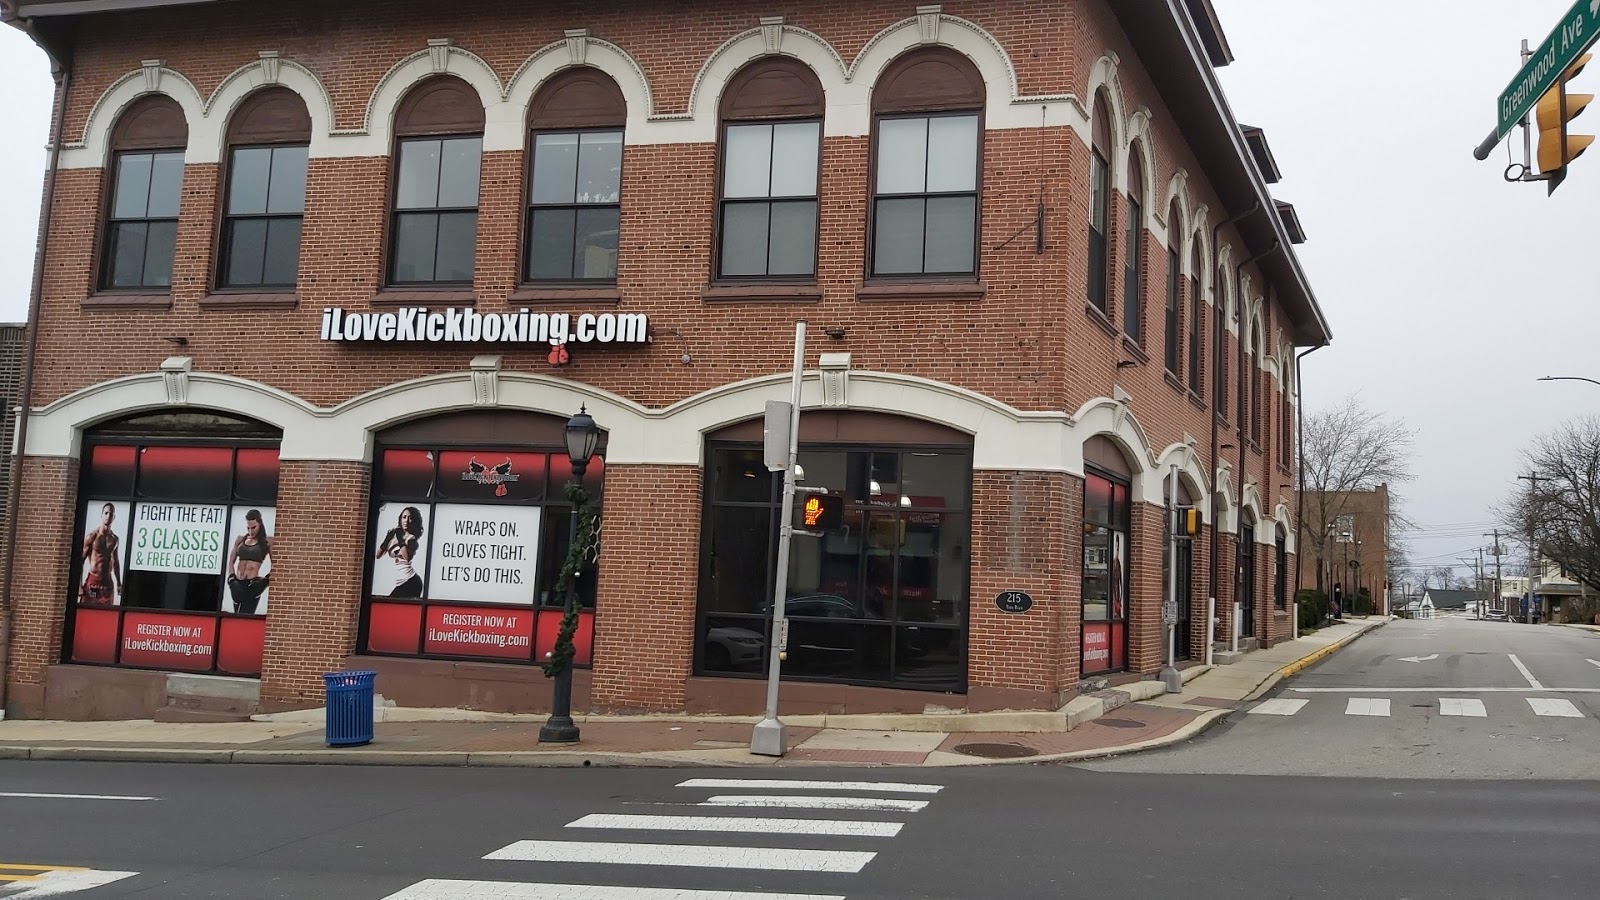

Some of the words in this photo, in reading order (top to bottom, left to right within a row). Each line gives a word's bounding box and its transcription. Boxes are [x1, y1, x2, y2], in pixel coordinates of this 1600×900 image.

[1502, 38, 1556, 121] Greenwood
[1561, 13, 1583, 55] Ave
[320, 307, 648, 345] iLoveKickboxing.com
[140, 504, 174, 522] FIGHT
[176, 507, 197, 523] THE
[200, 507, 223, 524] FAT!
[454, 519, 496, 537] WRAPS
[499, 521, 519, 538] ON.
[137, 527, 148, 548] 3
[152, 528, 219, 551] CLASSES
[135, 551, 144, 566] &
[147, 552, 171, 567] FREE
[174, 553, 217, 570] GLOVES!
[442, 542, 487, 559] GLOVES
[490, 544, 527, 561] TIGHT.
[441, 566, 471, 582] LET'S
[473, 567, 491, 583] DO
[494, 568, 523, 585] THIS.
[1006, 592, 1022, 603] 215
[137, 623, 171, 637] REGISTER
[173, 626, 190, 637] NOW
[192, 627, 202, 638] AT
[442, 613, 482, 626] REGISTER
[484, 615, 505, 628] NOW
[506, 617, 517, 629] AT
[124, 637, 212, 656] iLoveKickboxing.com
[428, 628, 529, 647] iLoveKickboxing.com
